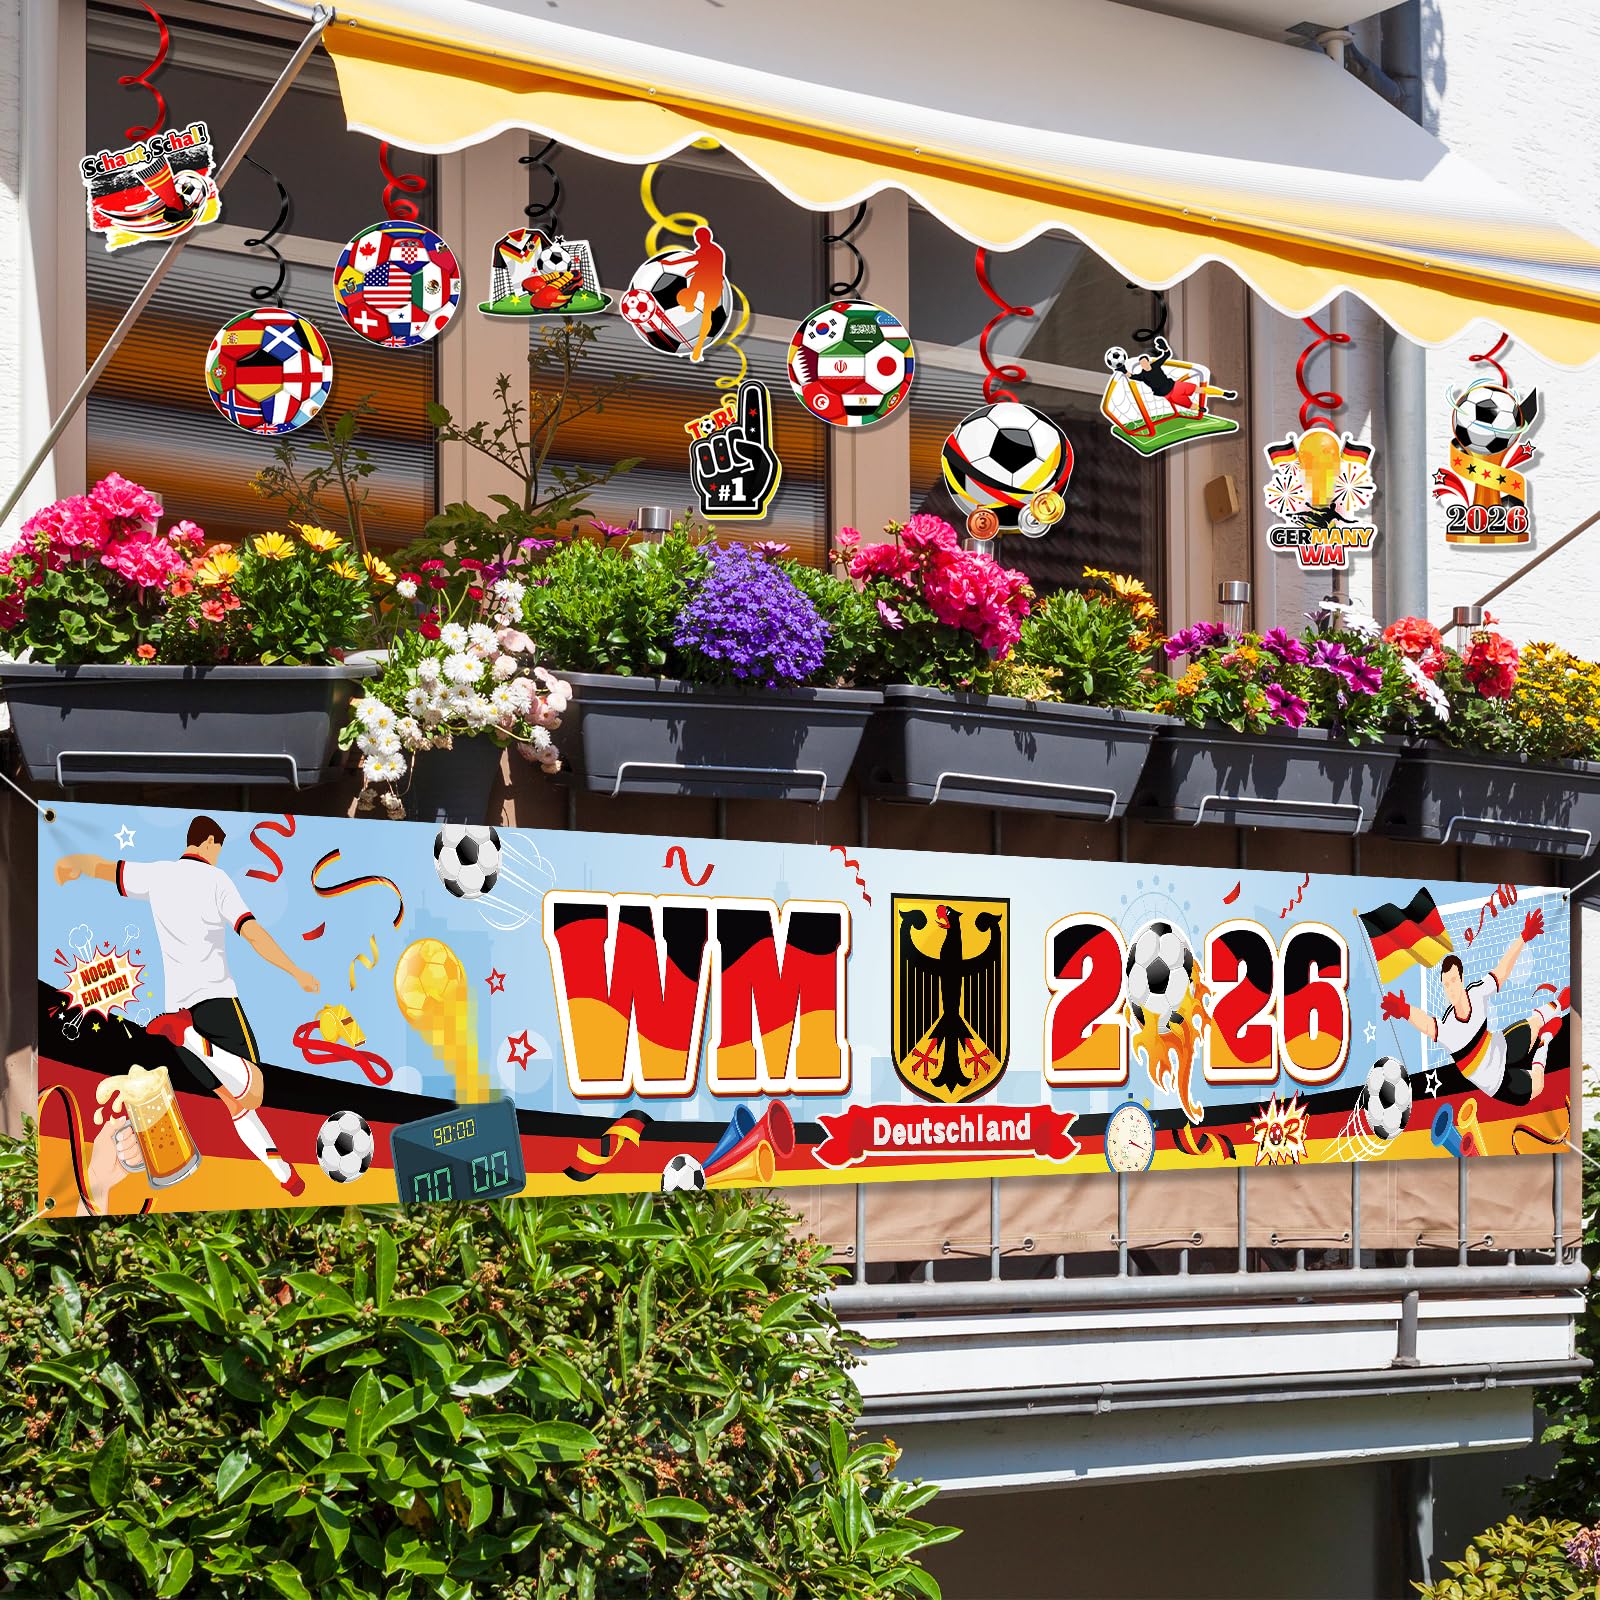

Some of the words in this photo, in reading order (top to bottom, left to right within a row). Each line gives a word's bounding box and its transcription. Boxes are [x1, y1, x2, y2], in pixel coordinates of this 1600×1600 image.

[82, 144, 152, 177] Schaut,
[150, 124, 207, 156] Schal!
[687, 406, 737, 439] TOR!
[718, 477, 747, 501] #1
[1448, 505, 1528, 533] 2026
[1271, 528, 1373, 546] GERMANY
[1299, 545, 1345, 564] WM
[79, 958, 117, 987] NOCH
[81, 987, 103, 1008] EIN
[100, 974, 130, 998] TOR!
[548, 897, 847, 1088] WM
[433, 1118, 475, 1146] 90:00
[872, 1112, 1031, 1146] Deutschland
[471, 1150, 509, 1193] 00
